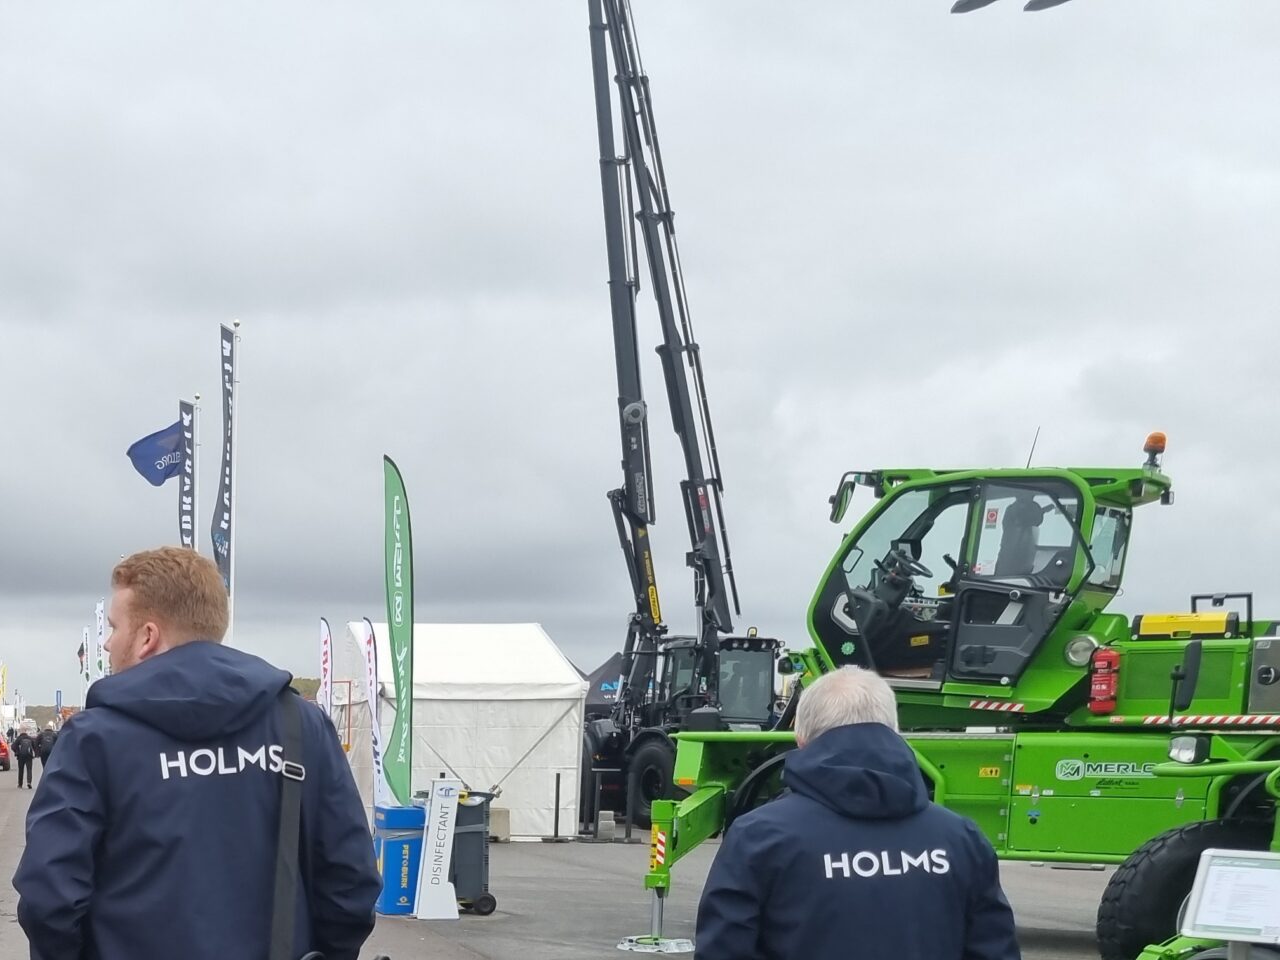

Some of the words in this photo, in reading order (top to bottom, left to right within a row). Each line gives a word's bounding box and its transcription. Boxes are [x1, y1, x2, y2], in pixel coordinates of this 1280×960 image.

[159, 744, 284, 780] HOLMS
[431, 803, 450, 886] DISINFECTANT
[823, 848, 951, 879] HOLMS
